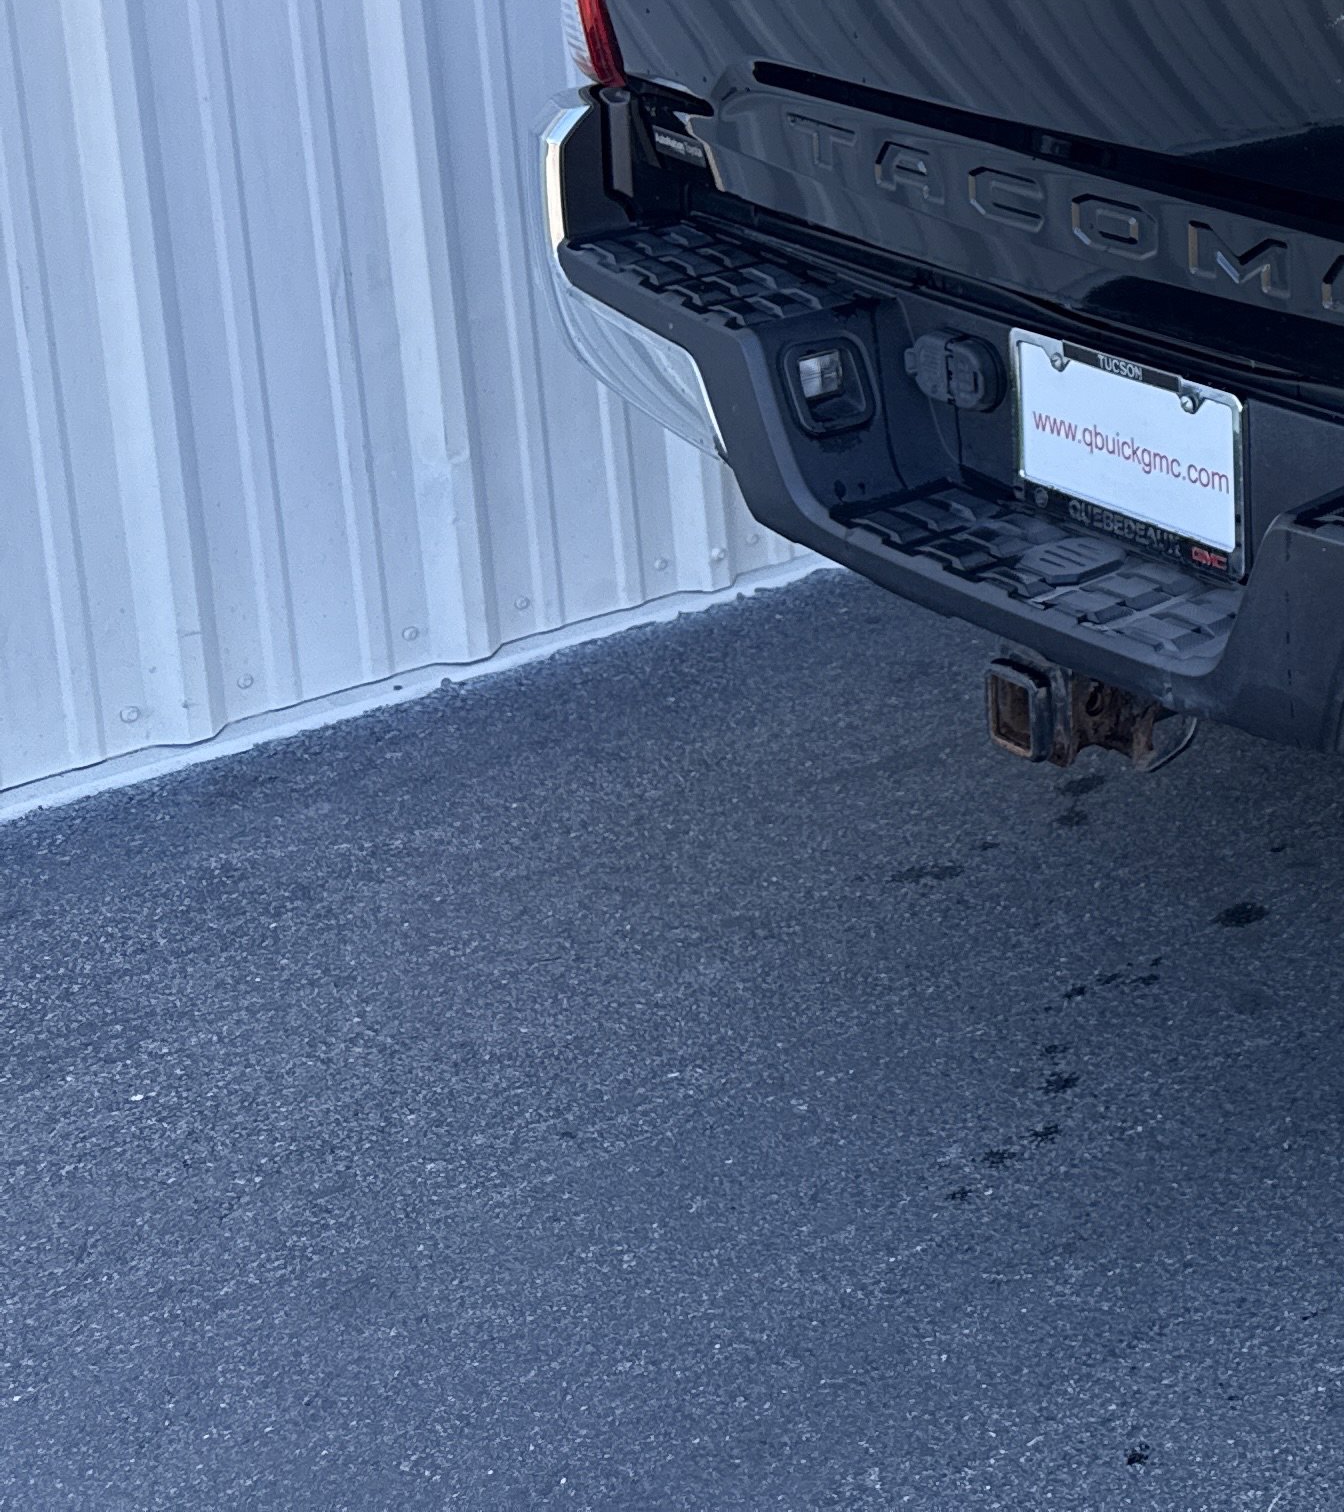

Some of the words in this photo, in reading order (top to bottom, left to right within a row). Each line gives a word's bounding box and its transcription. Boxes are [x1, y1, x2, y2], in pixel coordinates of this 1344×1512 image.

[1096, 353, 1144, 382] TUCSON
[1032, 410, 1231, 495] www.qbuickgmc.com
[1190, 545, 1229, 571] GMC
